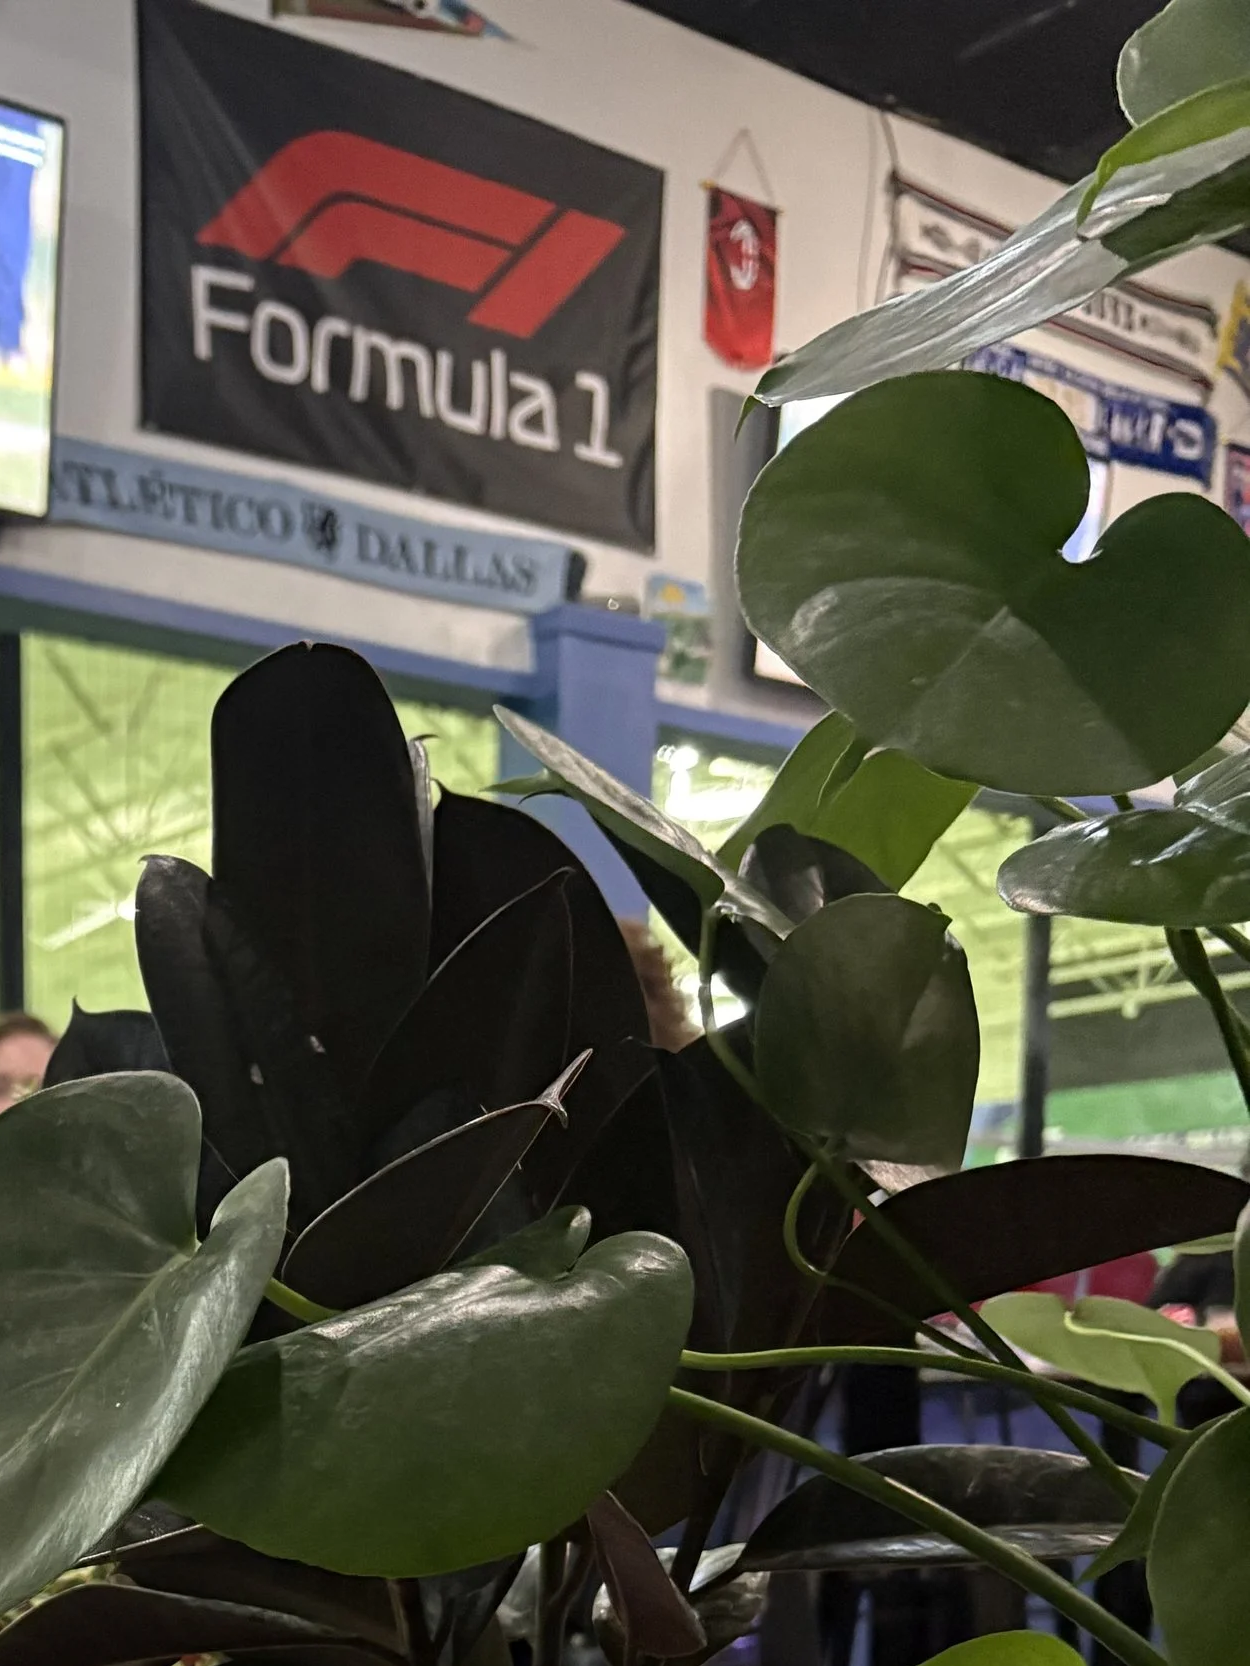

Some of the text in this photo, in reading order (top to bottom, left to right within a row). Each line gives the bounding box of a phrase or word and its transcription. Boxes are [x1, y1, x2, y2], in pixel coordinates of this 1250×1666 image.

[191, 264, 623, 468] Formula 1
[356, 523, 539, 596] DALLAS
